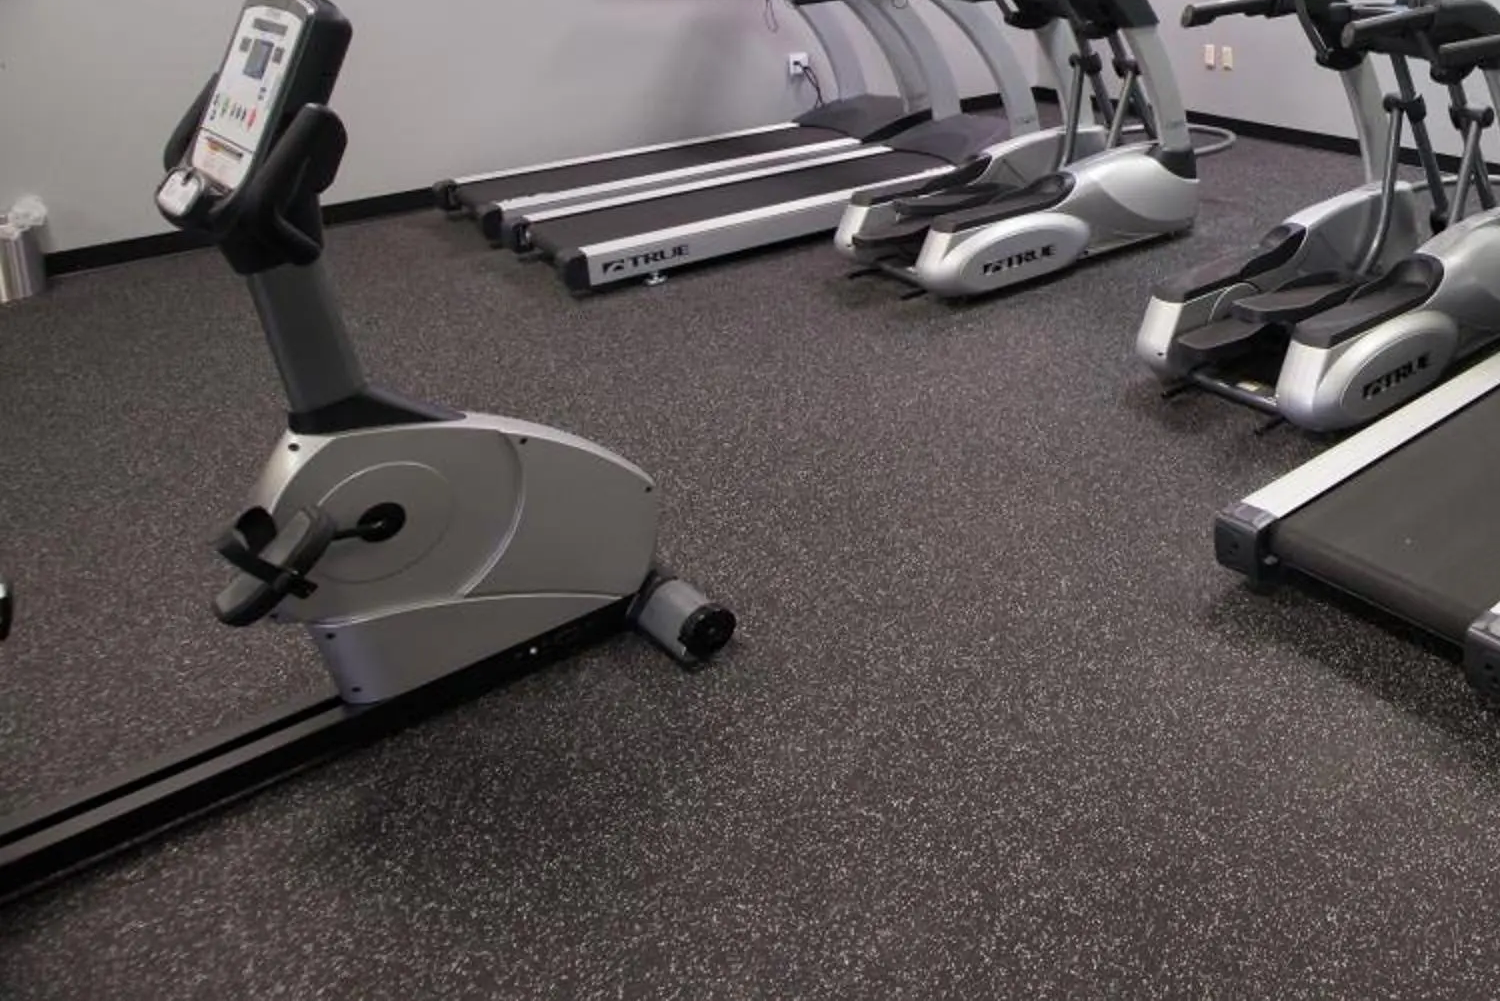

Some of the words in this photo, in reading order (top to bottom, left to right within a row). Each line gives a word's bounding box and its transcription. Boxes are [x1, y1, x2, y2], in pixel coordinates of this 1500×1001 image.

[629, 244, 689, 268] TRUE
[1003, 244, 1056, 268] TRUE
[1381, 352, 1431, 388] TRUE
